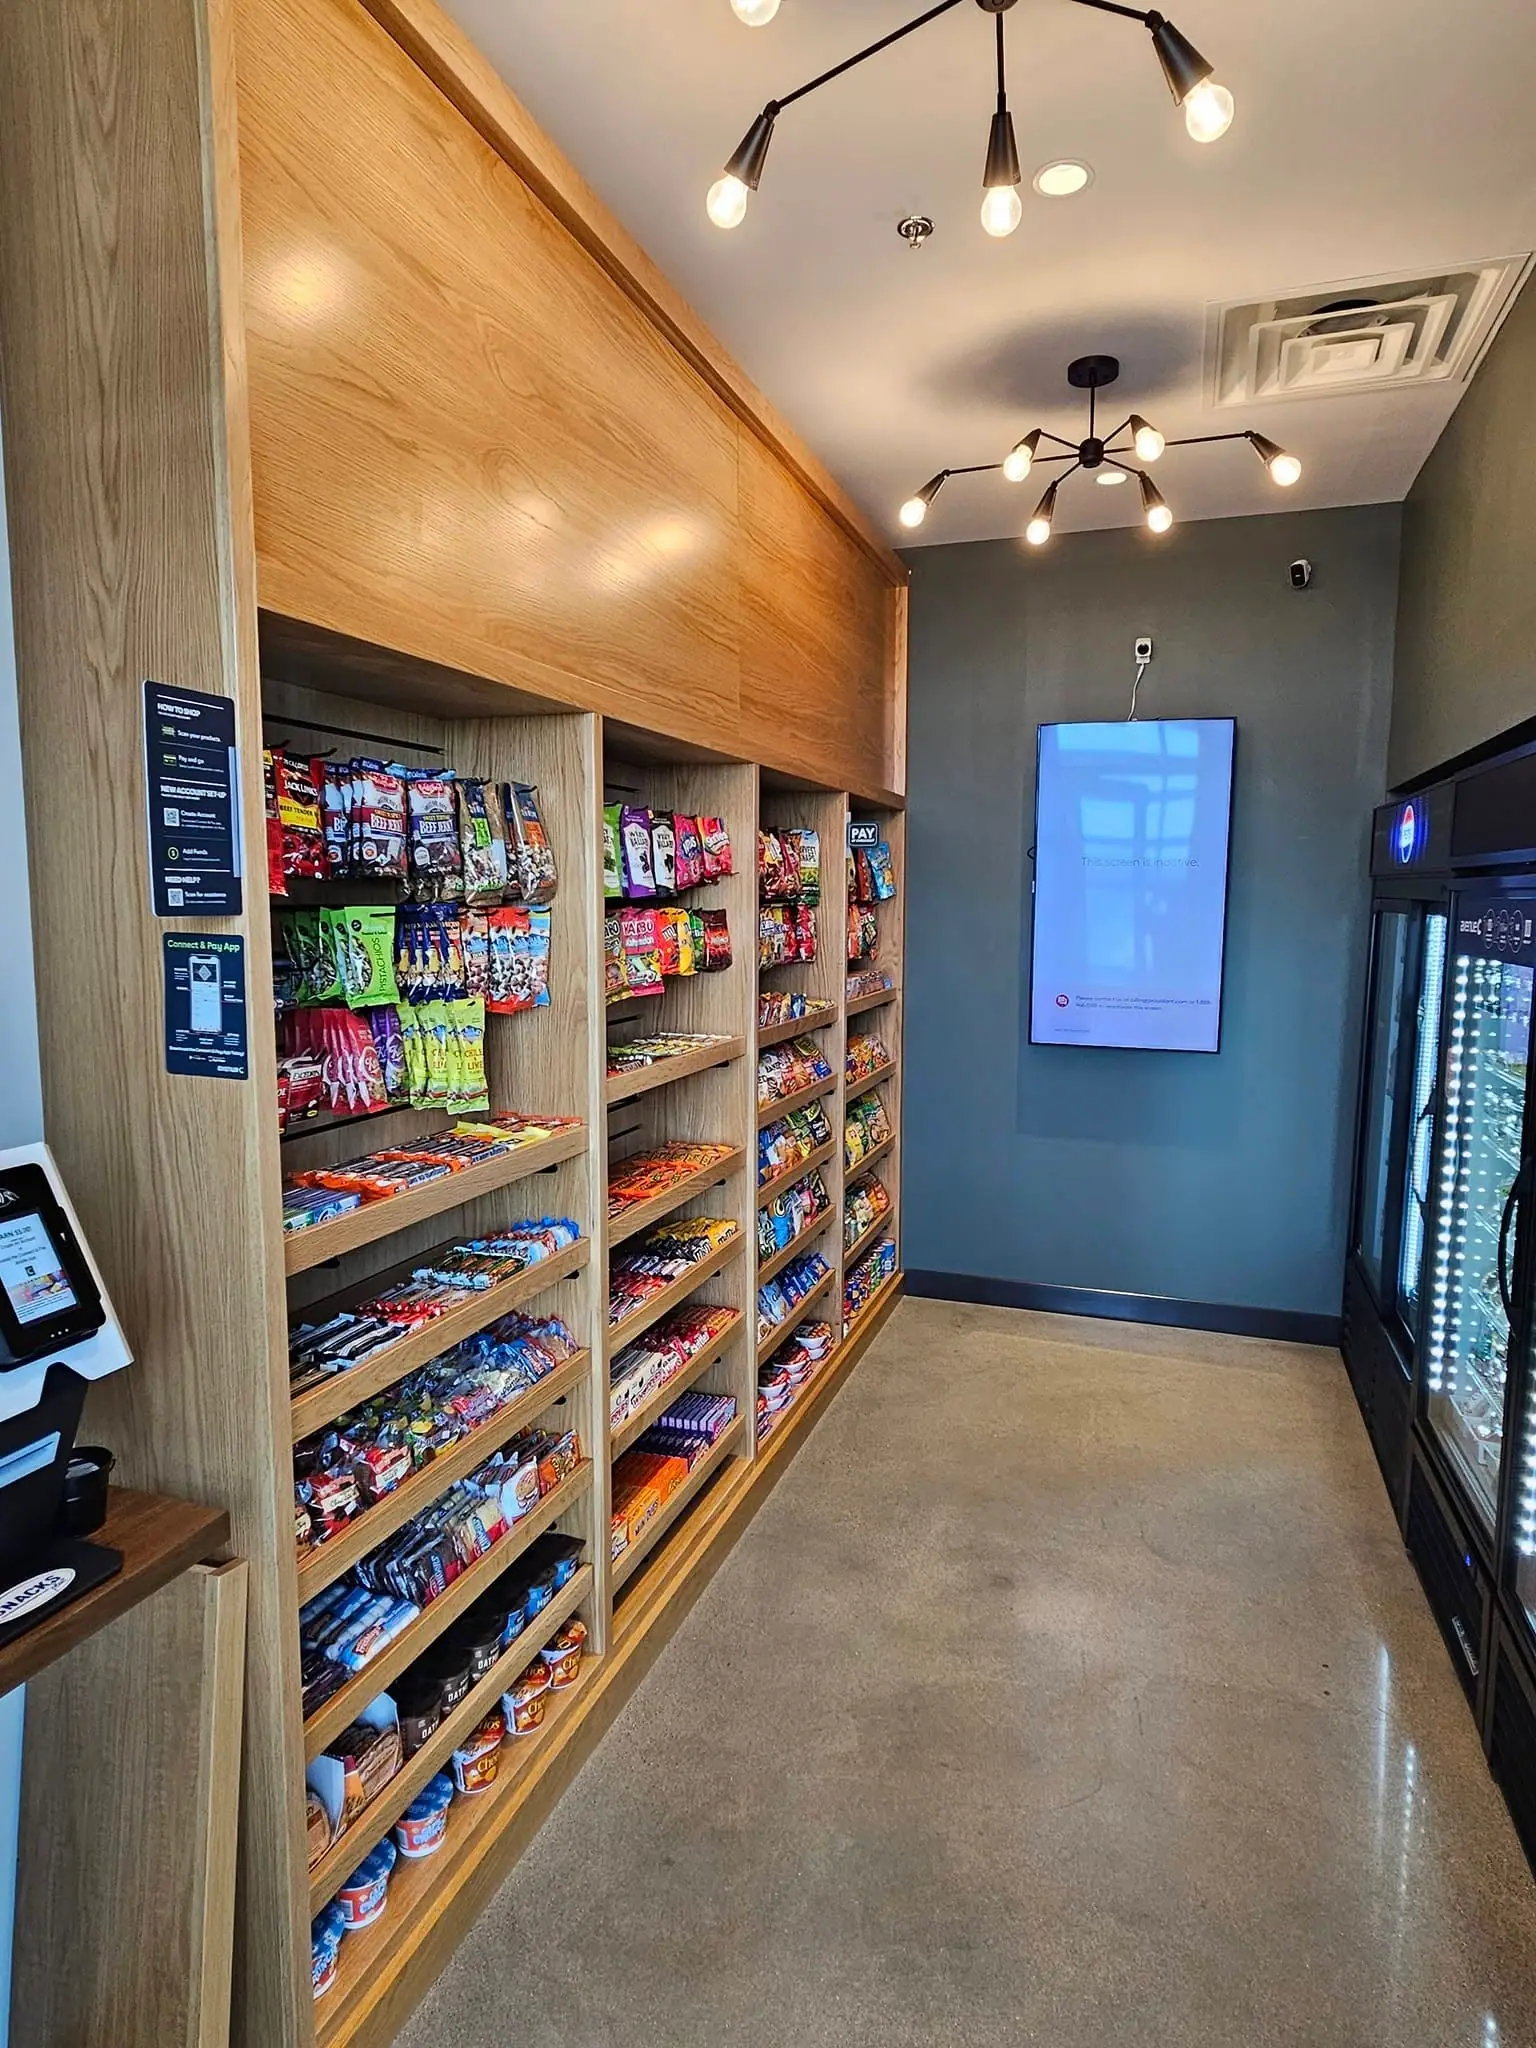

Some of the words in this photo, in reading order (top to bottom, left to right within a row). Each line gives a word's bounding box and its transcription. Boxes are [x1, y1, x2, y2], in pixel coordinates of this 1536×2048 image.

[157, 702, 174, 713] HOW
[174, 705, 184, 715] TO
[183, 707, 201, 717] SHOP
[160, 785, 177, 793] NEW
[176, 786, 207, 797] ACCOUNT
[419, 820, 438, 834] BEEF
[851, 827, 875, 839] PAY
[167, 939, 199, 950] Connect
[199, 941, 206, 950] &
[206, 941, 223, 953] Pay
[223, 942, 241, 953] App
[371, 937, 388, 994] PISTACHIOS
